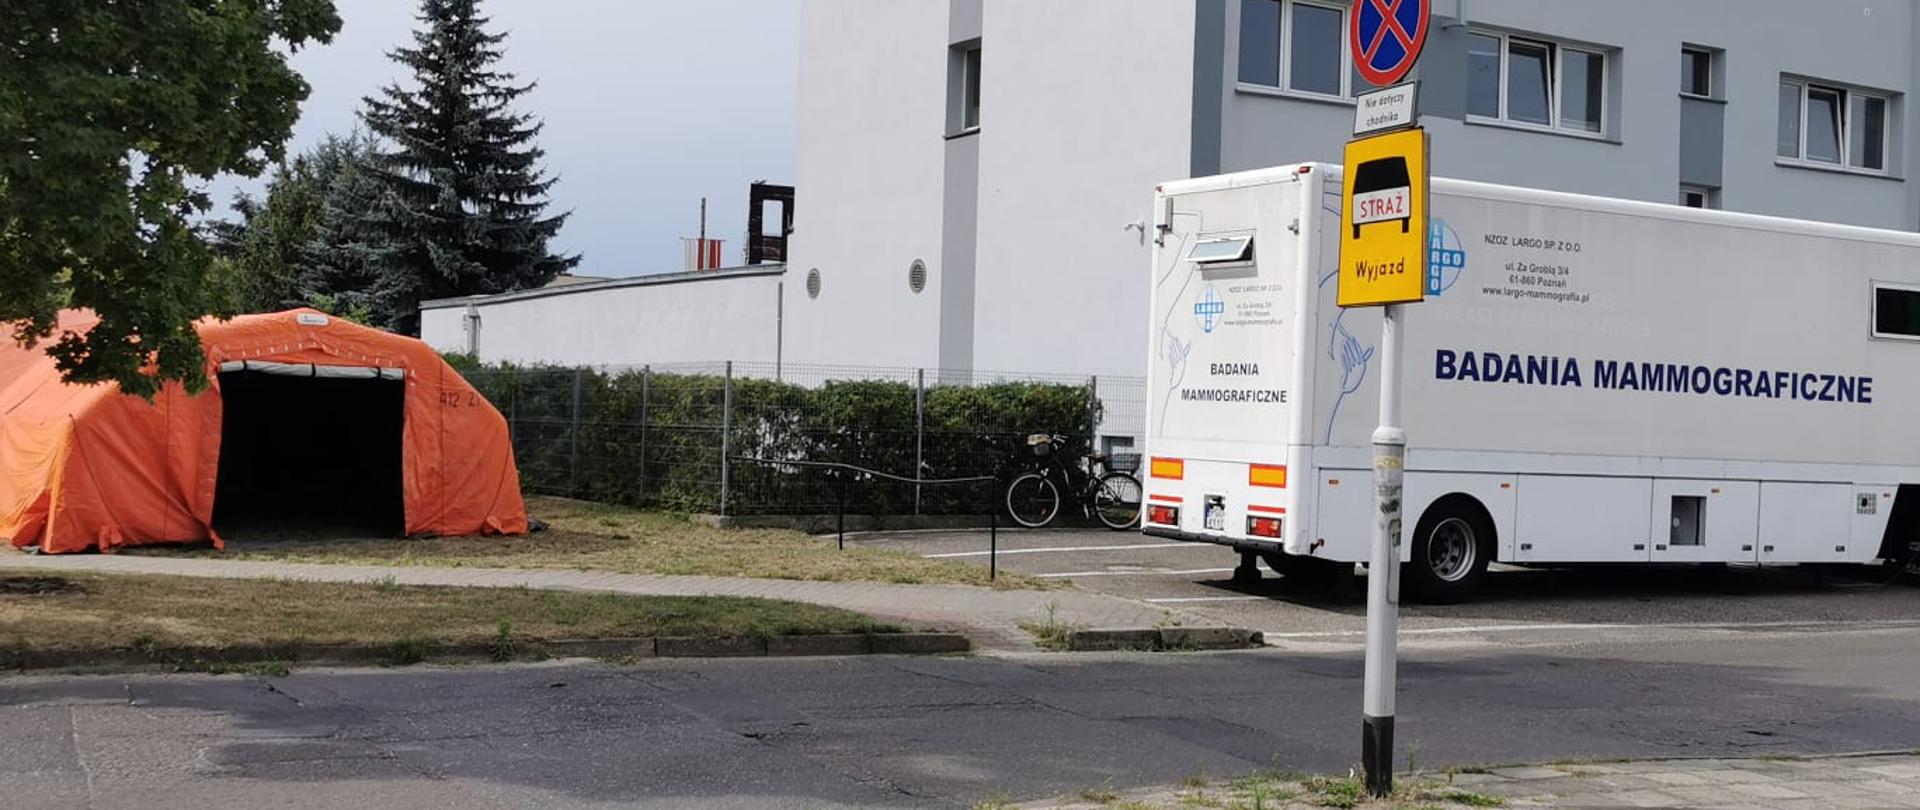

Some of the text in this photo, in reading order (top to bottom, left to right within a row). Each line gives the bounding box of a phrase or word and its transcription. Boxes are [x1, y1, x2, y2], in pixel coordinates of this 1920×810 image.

[1365, 98, 1377, 109] Nie
[1360, 192, 1403, 218] STRAŻ
[1512, 237, 1542, 249] LARGO
[1355, 256, 1404, 283] Wyjazd
[1517, 262, 1527, 272] Za
[1482, 287, 1590, 303] www.largo-mammografia.pl
[1210, 363, 1259, 376] BADANIA
[1435, 349, 1873, 404] BADANIA MAMMOGRAFICZNE
[1181, 389, 1288, 403] MAMMOGRAFICZNE
